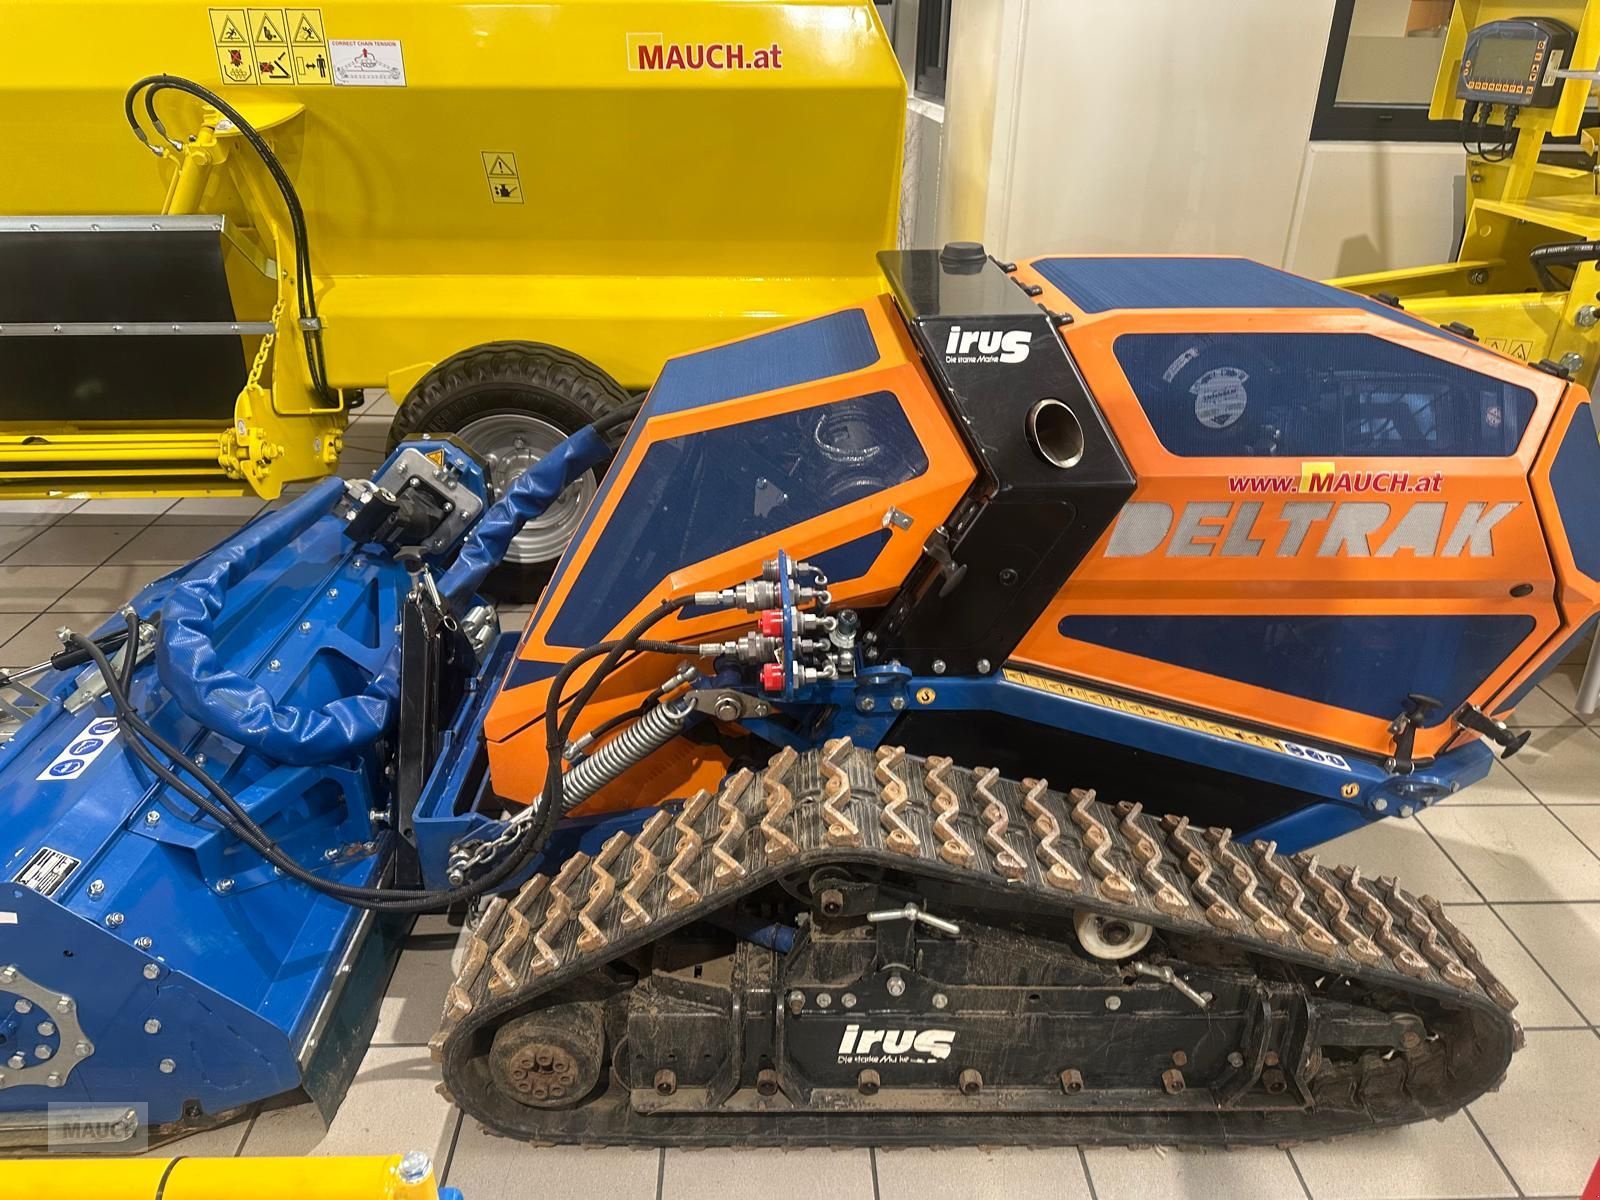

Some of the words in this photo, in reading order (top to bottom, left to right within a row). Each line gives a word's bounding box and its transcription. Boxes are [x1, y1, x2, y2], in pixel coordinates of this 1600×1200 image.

[638, 44, 782, 70] MAUCH.at
[945, 326, 1033, 364] irus
[945, 355, 957, 364] Die
[1104, 501, 1522, 558] DELTRAK
[879, 1054, 910, 1064] Make
